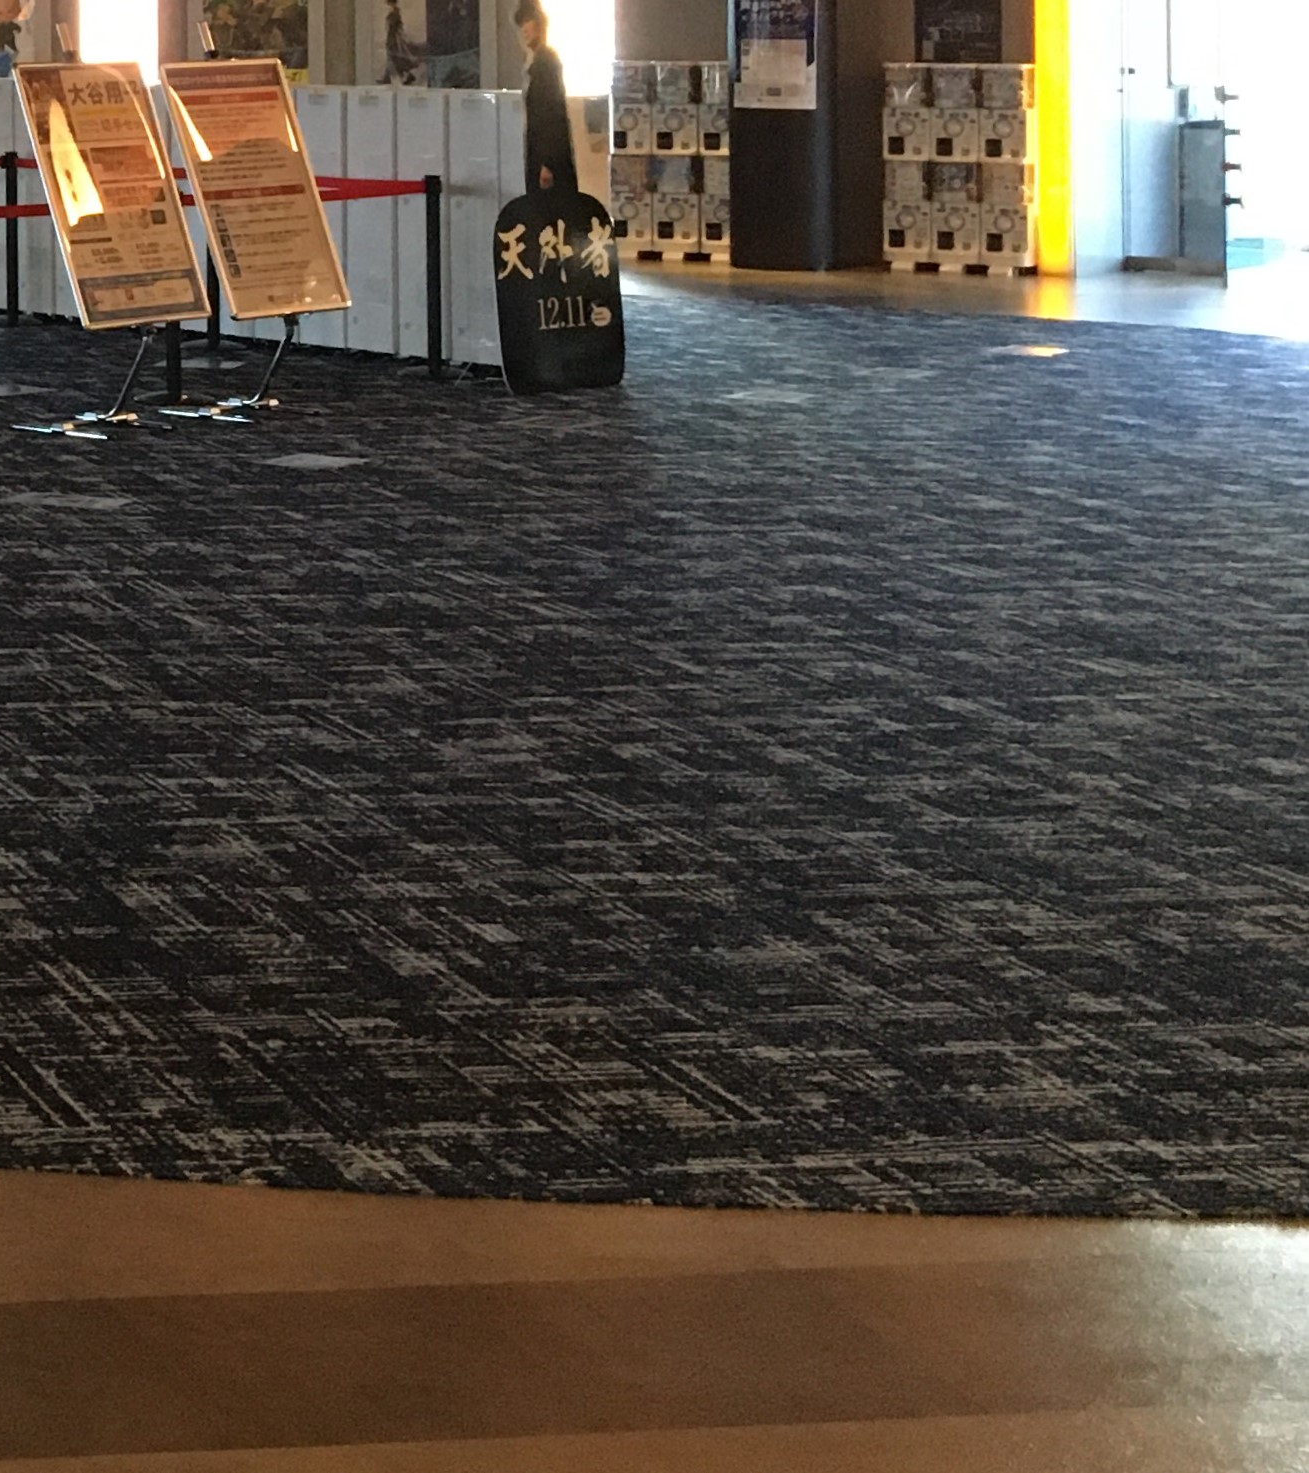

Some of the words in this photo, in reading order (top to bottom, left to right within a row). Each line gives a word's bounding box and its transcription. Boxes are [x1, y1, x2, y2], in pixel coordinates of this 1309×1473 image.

[497, 216, 614, 284] 天外者
[537, 295, 587, 330] 12.11
